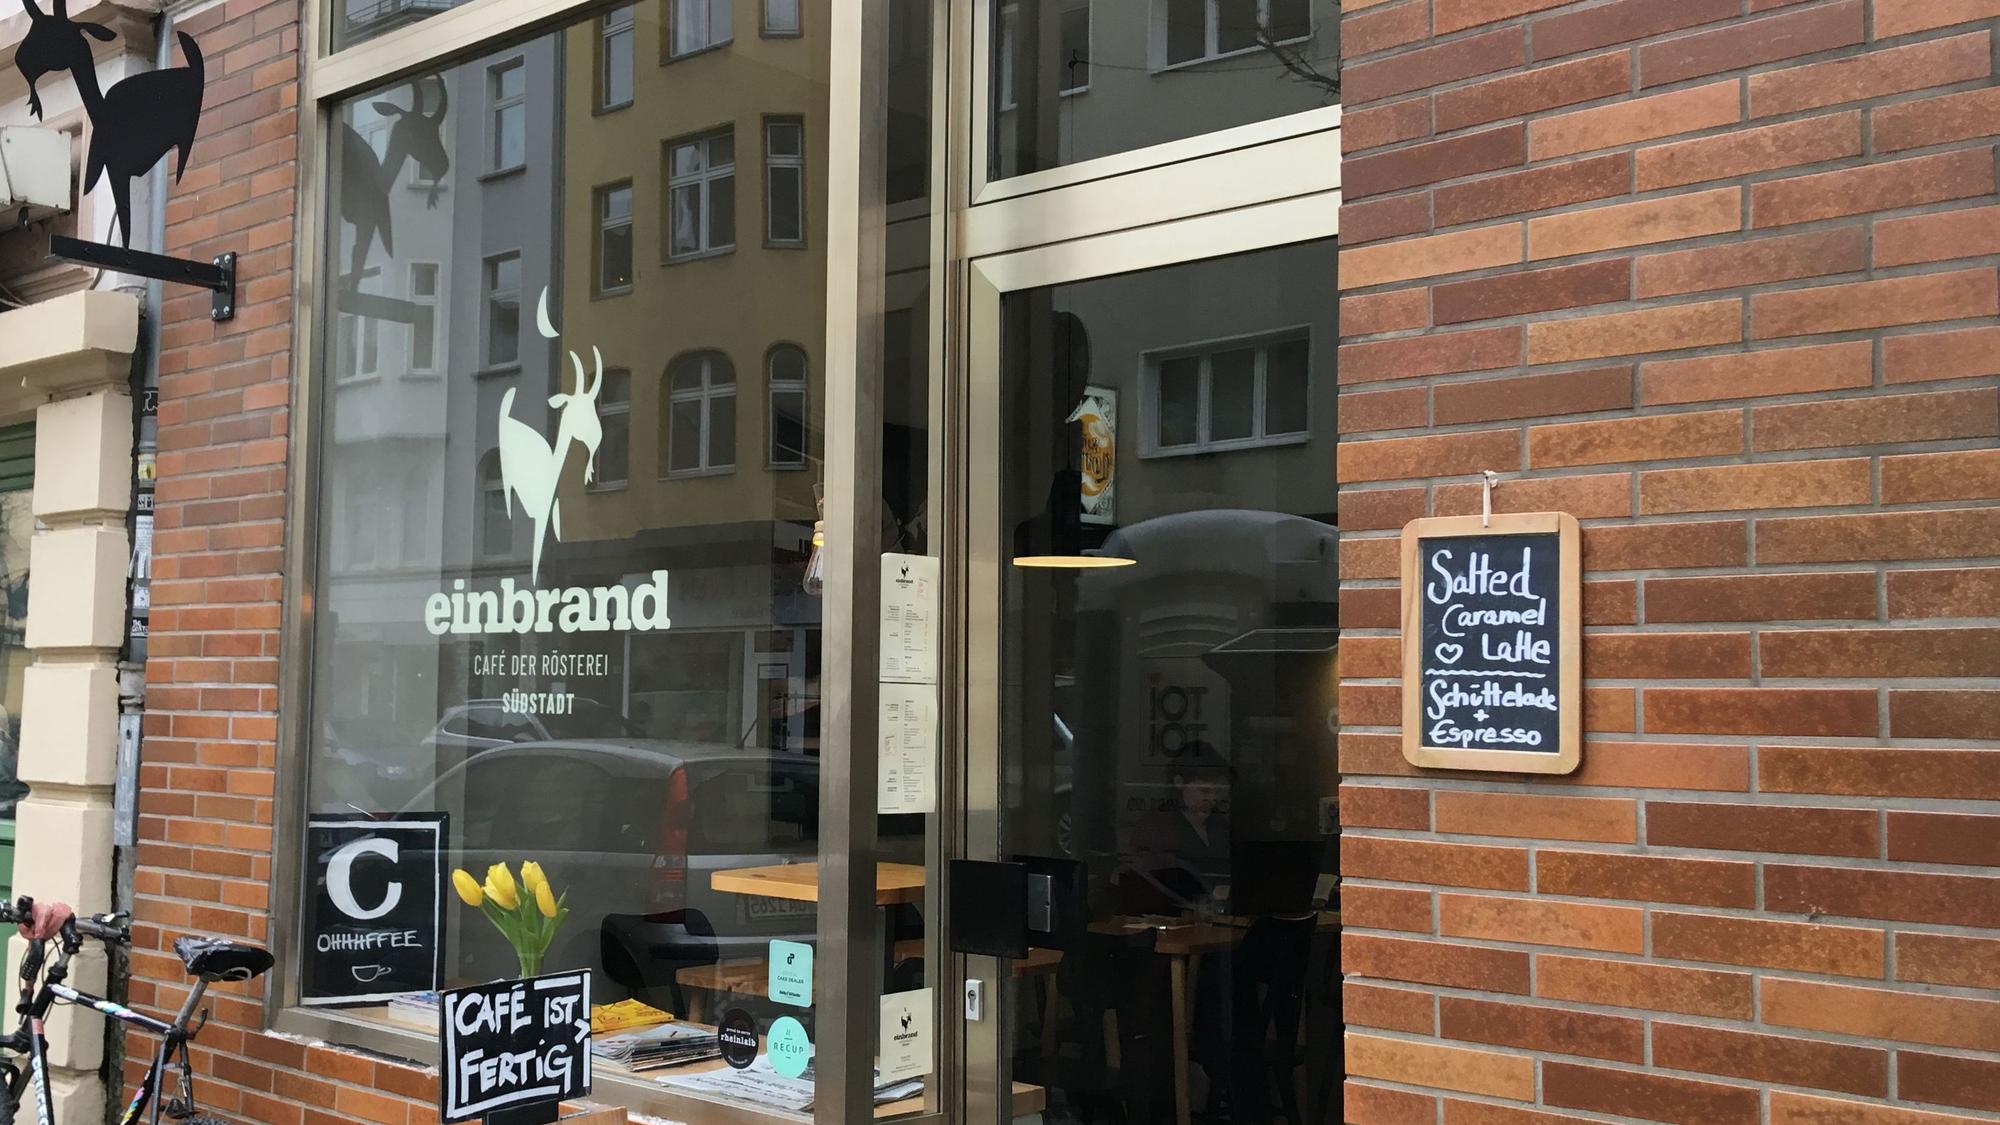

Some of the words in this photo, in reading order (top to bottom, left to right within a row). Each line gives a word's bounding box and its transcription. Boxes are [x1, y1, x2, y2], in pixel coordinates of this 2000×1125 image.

[1427, 546, 1540, 604] Salted
[425, 569, 671, 635] einbrand
[1442, 598, 1546, 637] Caramel
[1482, 630, 1550, 664] Latte
[474, 650, 506, 676] CAFÉ
[511, 655, 536, 676] DER
[542, 650, 608, 676] RÖSTEREI
[502, 688, 575, 715] SÜDSTADT
[1429, 719, 1542, 747] Espresso
[326, 838, 403, 920] C
[454, 984, 532, 1036] CAFÉ
[544, 994, 580, 1028] IST
[720, 1033, 757, 1047] rheinlaib
[773, 1041, 804, 1055] RECUP
[893, 1030, 918, 1042] einbrand
